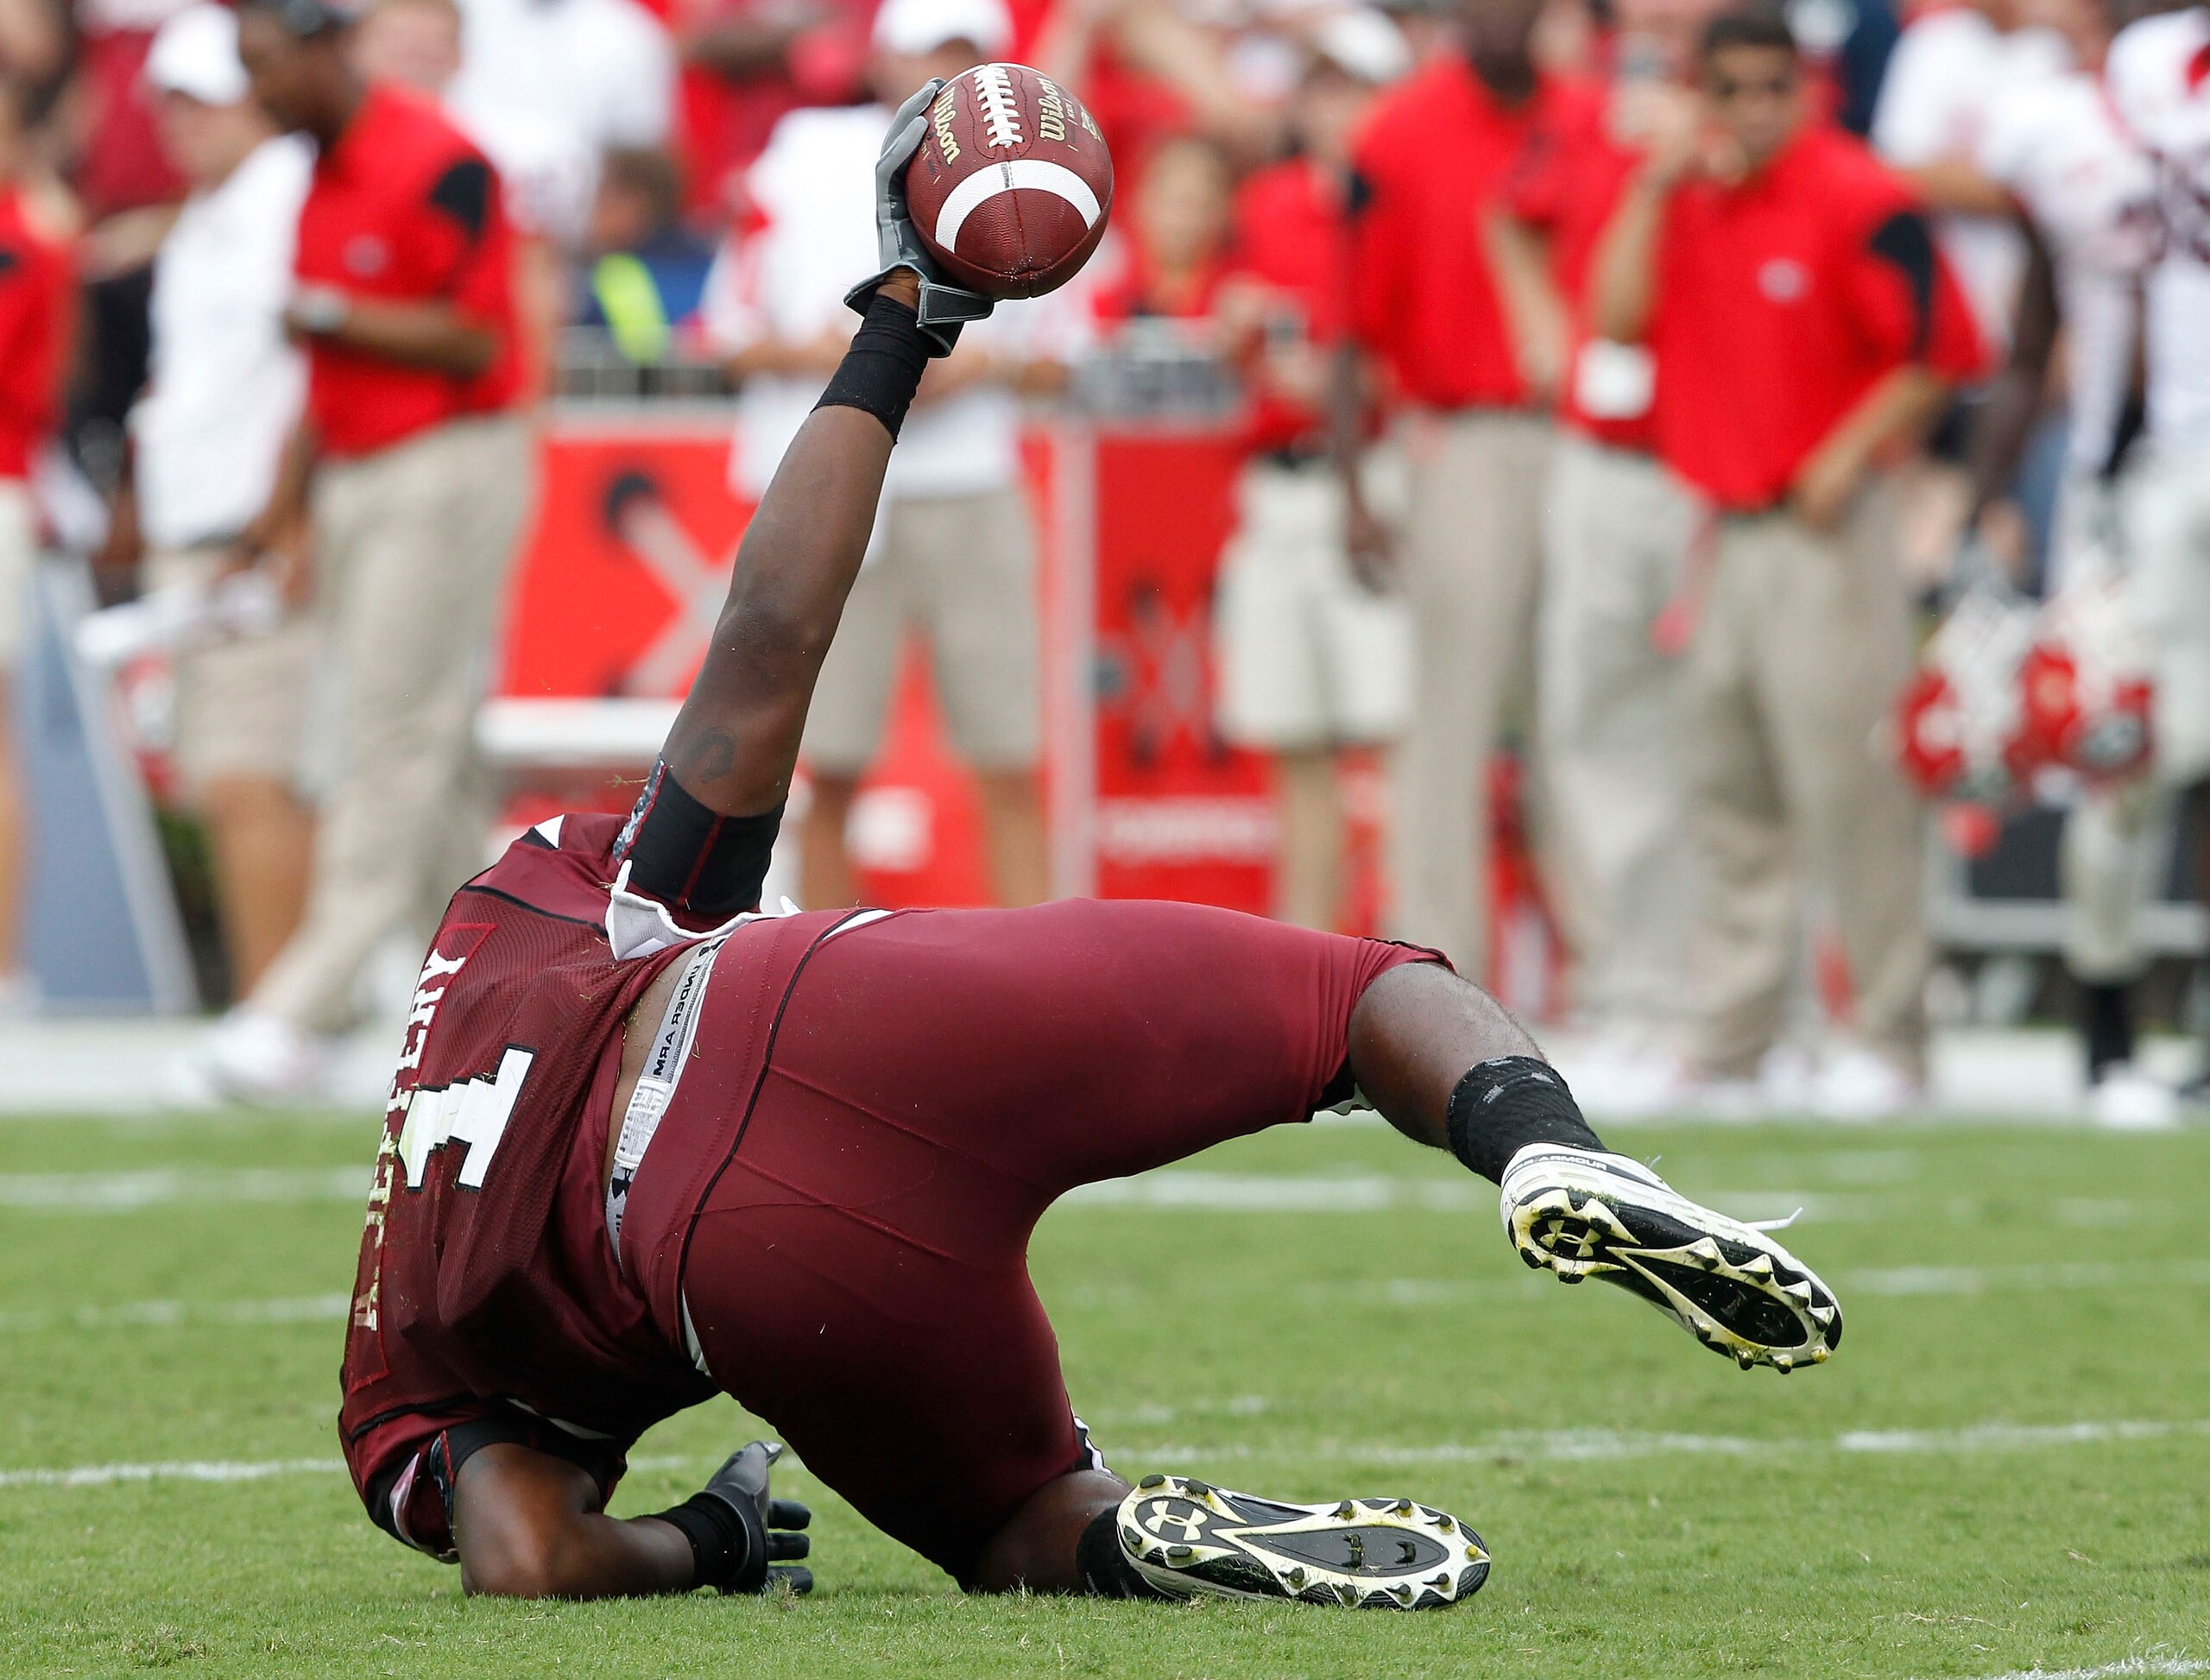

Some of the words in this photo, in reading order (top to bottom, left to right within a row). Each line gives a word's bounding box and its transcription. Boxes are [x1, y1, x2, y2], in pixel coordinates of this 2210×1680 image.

[933, 86, 961, 165] Wilson
[1036, 77, 1065, 141] Wilson
[397, 1044, 538, 1192] 1
[1538, 1156, 1607, 1171] ARMOUR
